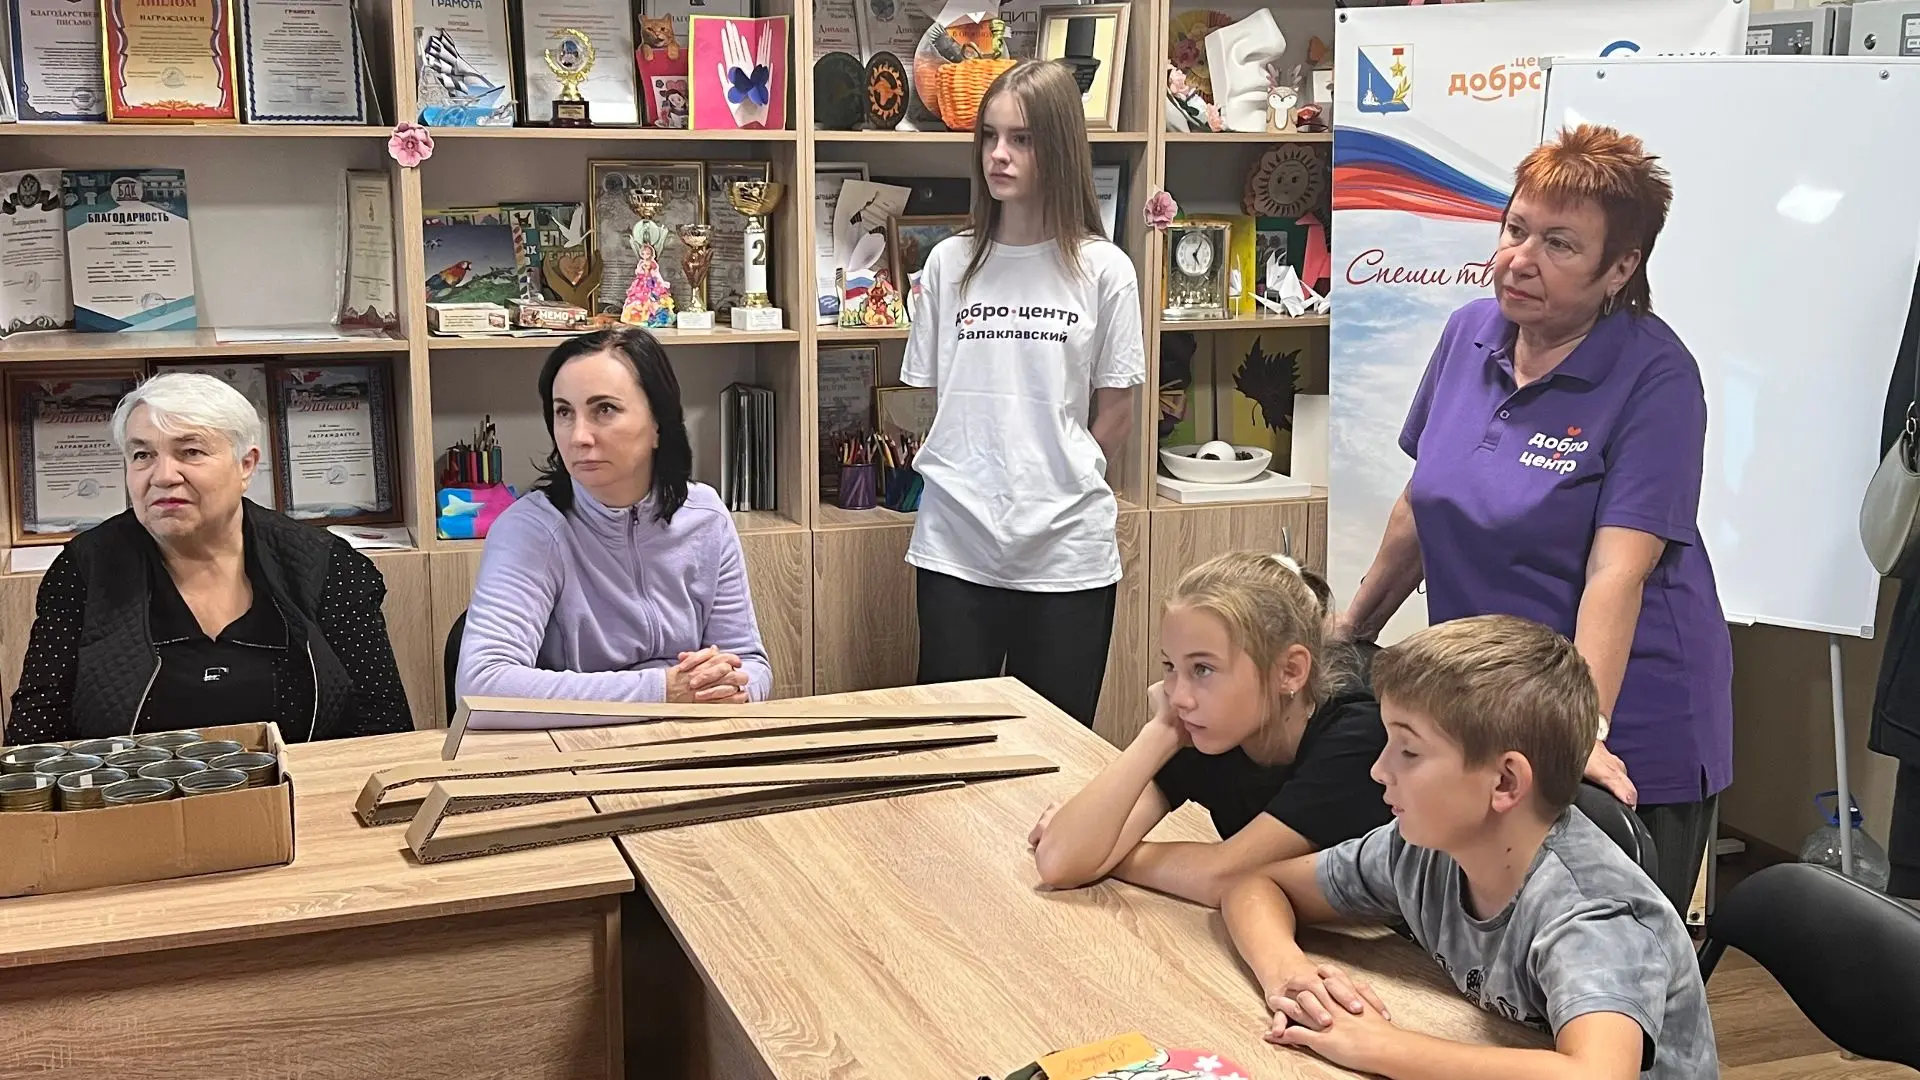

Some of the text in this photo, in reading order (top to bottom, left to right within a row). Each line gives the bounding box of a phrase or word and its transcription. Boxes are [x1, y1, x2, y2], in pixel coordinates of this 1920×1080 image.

[87, 212, 170, 224] БЛАГОДАРНОСТЬ
[752, 239, 766, 266] 2
[1345, 249, 1452, 286] Спеши
[957, 328, 1068, 344] балаклавский
